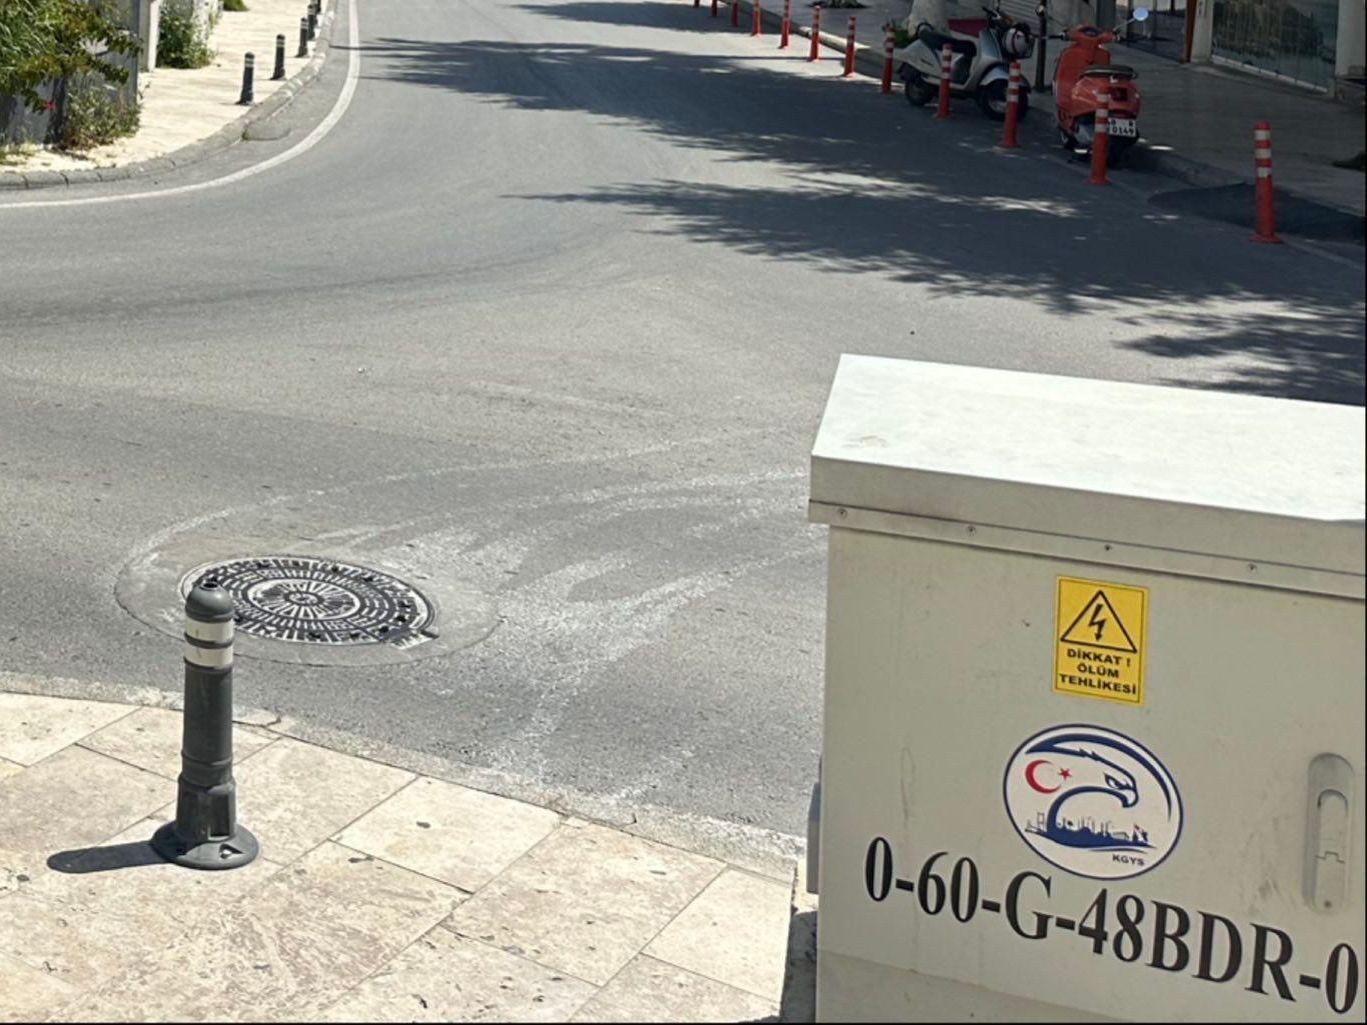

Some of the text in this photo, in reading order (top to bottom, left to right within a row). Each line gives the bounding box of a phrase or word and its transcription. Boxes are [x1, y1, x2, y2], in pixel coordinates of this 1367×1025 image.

[1066, 647, 1122, 666] DİKKAT
[1077, 661, 1119, 679] ÖLÜM
[1059, 673, 1136, 695] TEHLİKESİ
[1112, 853, 1146, 867] KGYS
[864, 836, 1359, 1015] 0-60-G-48BDR-0
